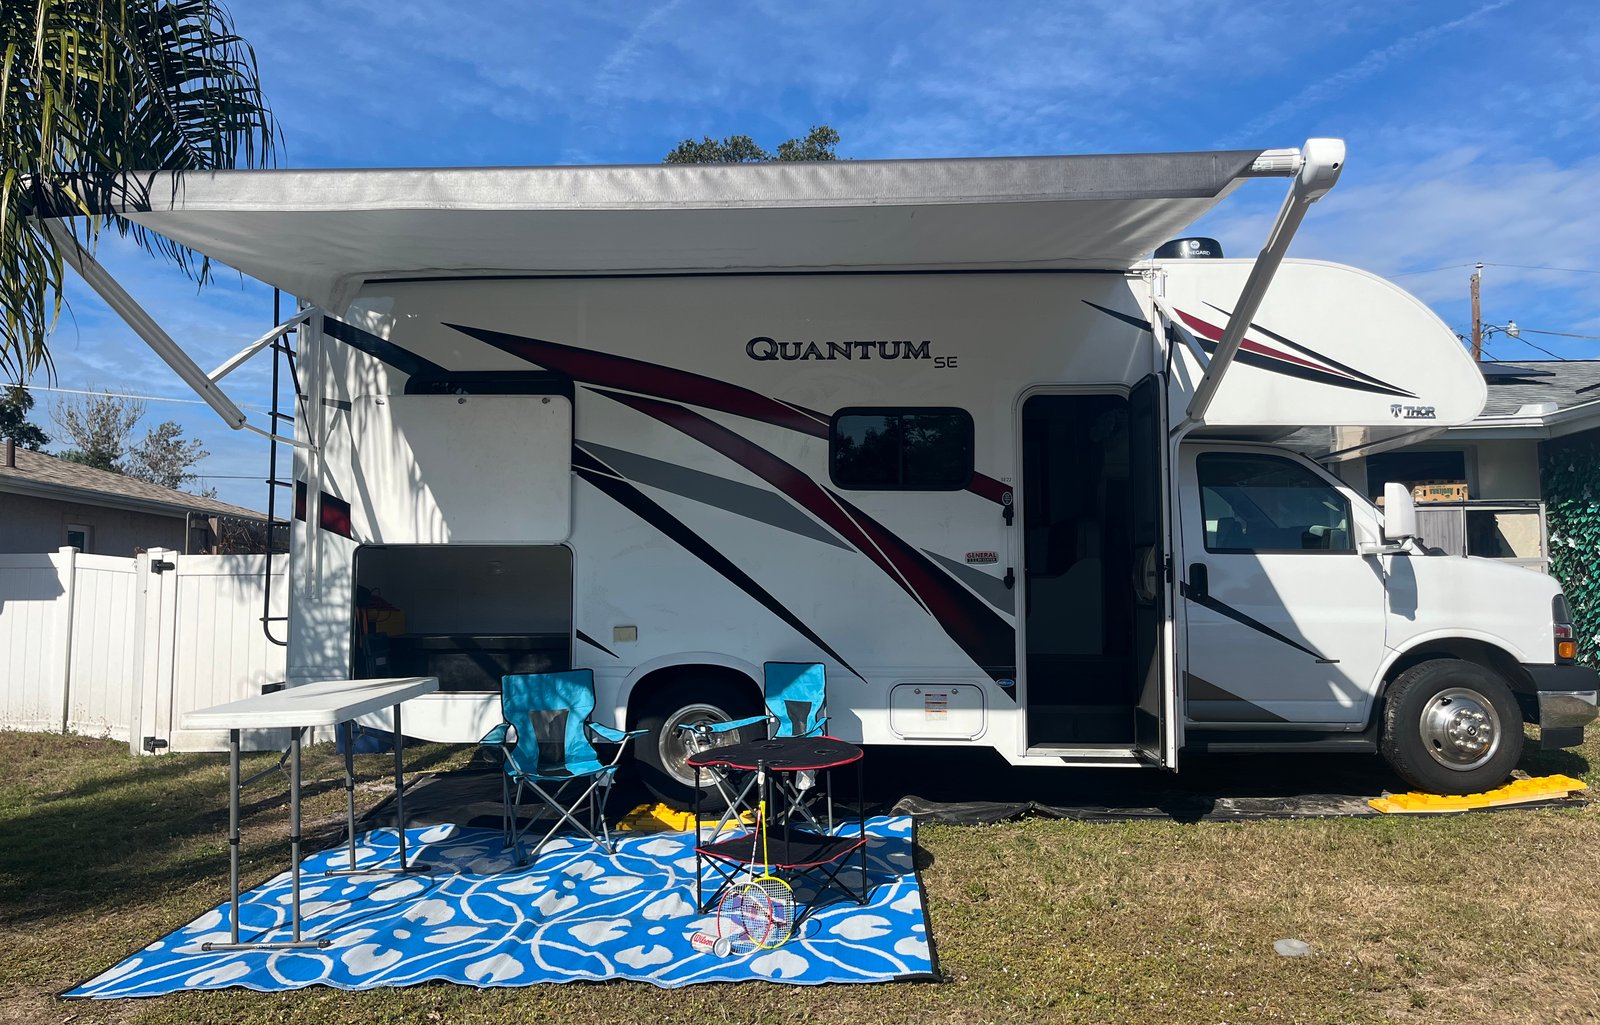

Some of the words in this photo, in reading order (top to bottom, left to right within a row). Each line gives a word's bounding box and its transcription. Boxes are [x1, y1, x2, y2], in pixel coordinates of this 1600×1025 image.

[745, 336, 931, 361] QUANTUM
[934, 356, 958, 368] SE
[1403, 406, 1436, 417] THOR
[693, 934, 714, 947] Wilson
